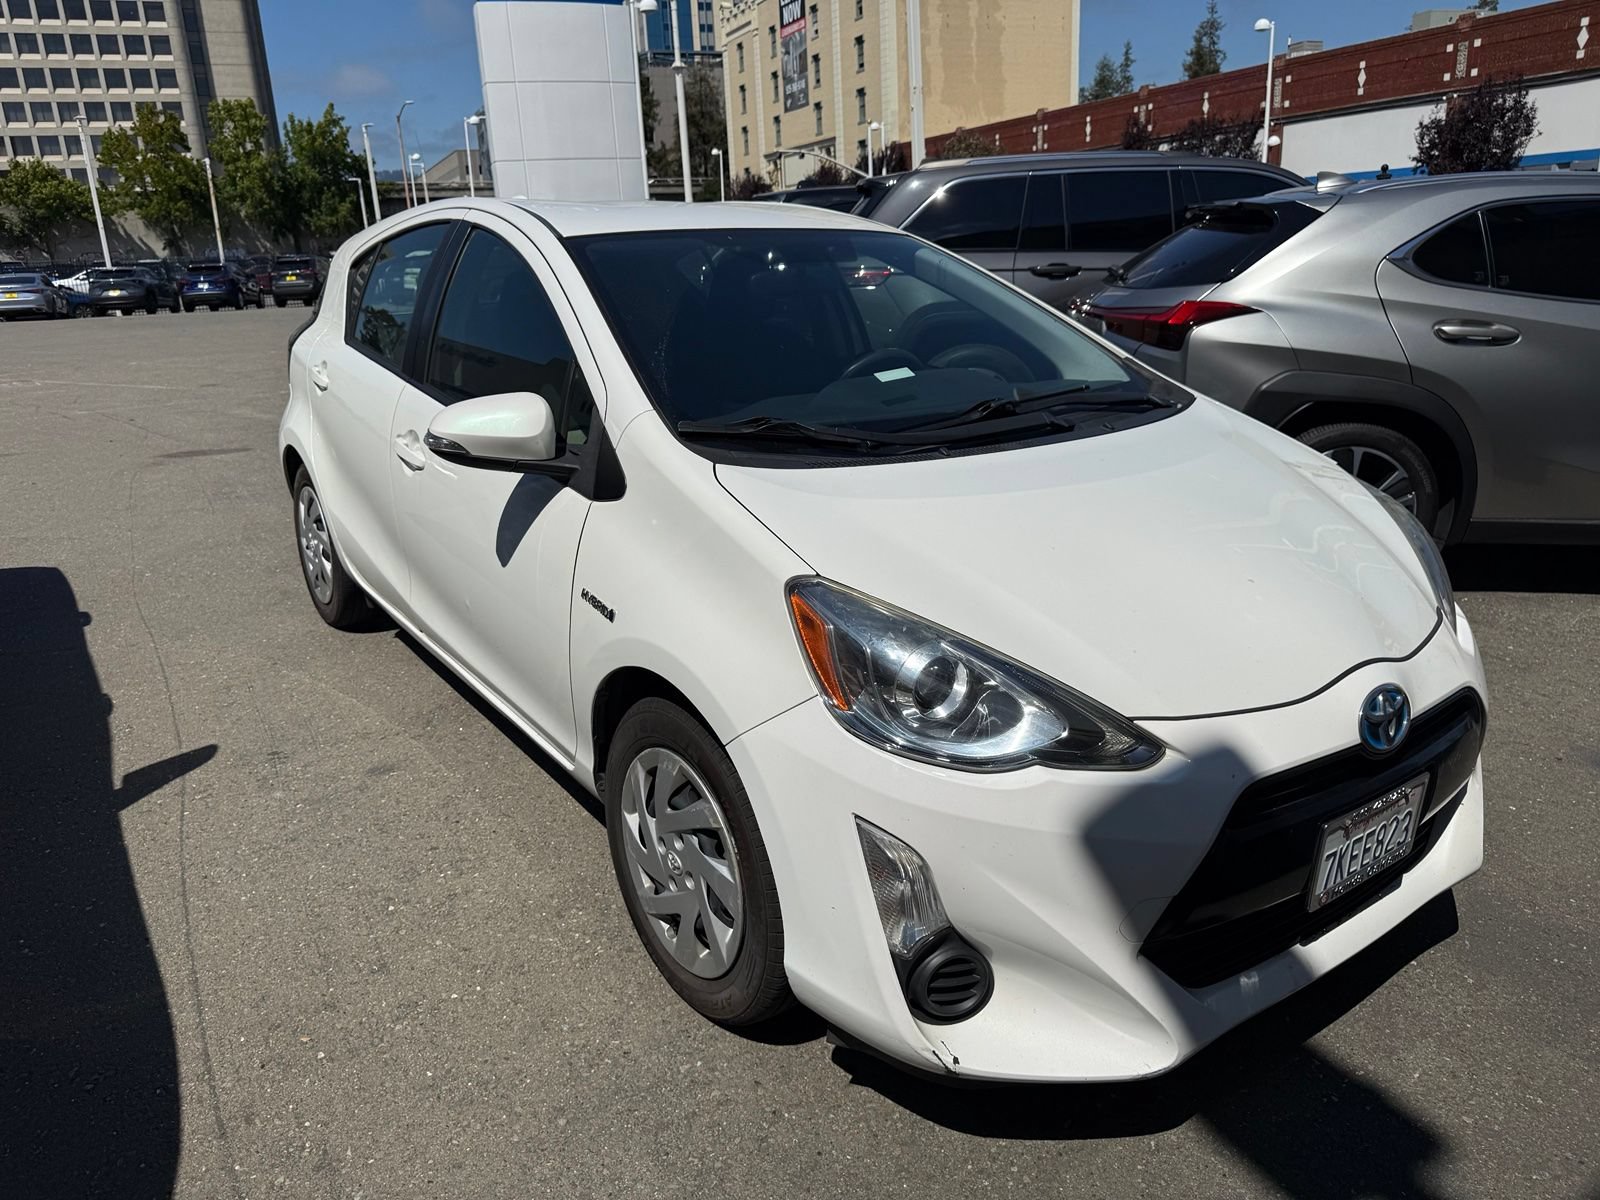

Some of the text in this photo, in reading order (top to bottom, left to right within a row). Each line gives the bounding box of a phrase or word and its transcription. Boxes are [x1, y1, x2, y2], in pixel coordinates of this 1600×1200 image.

[782, 1, 802, 25] NOW
[581, 588, 611, 620] HYBRID
[1323, 809, 1413, 890] 7KEE823
